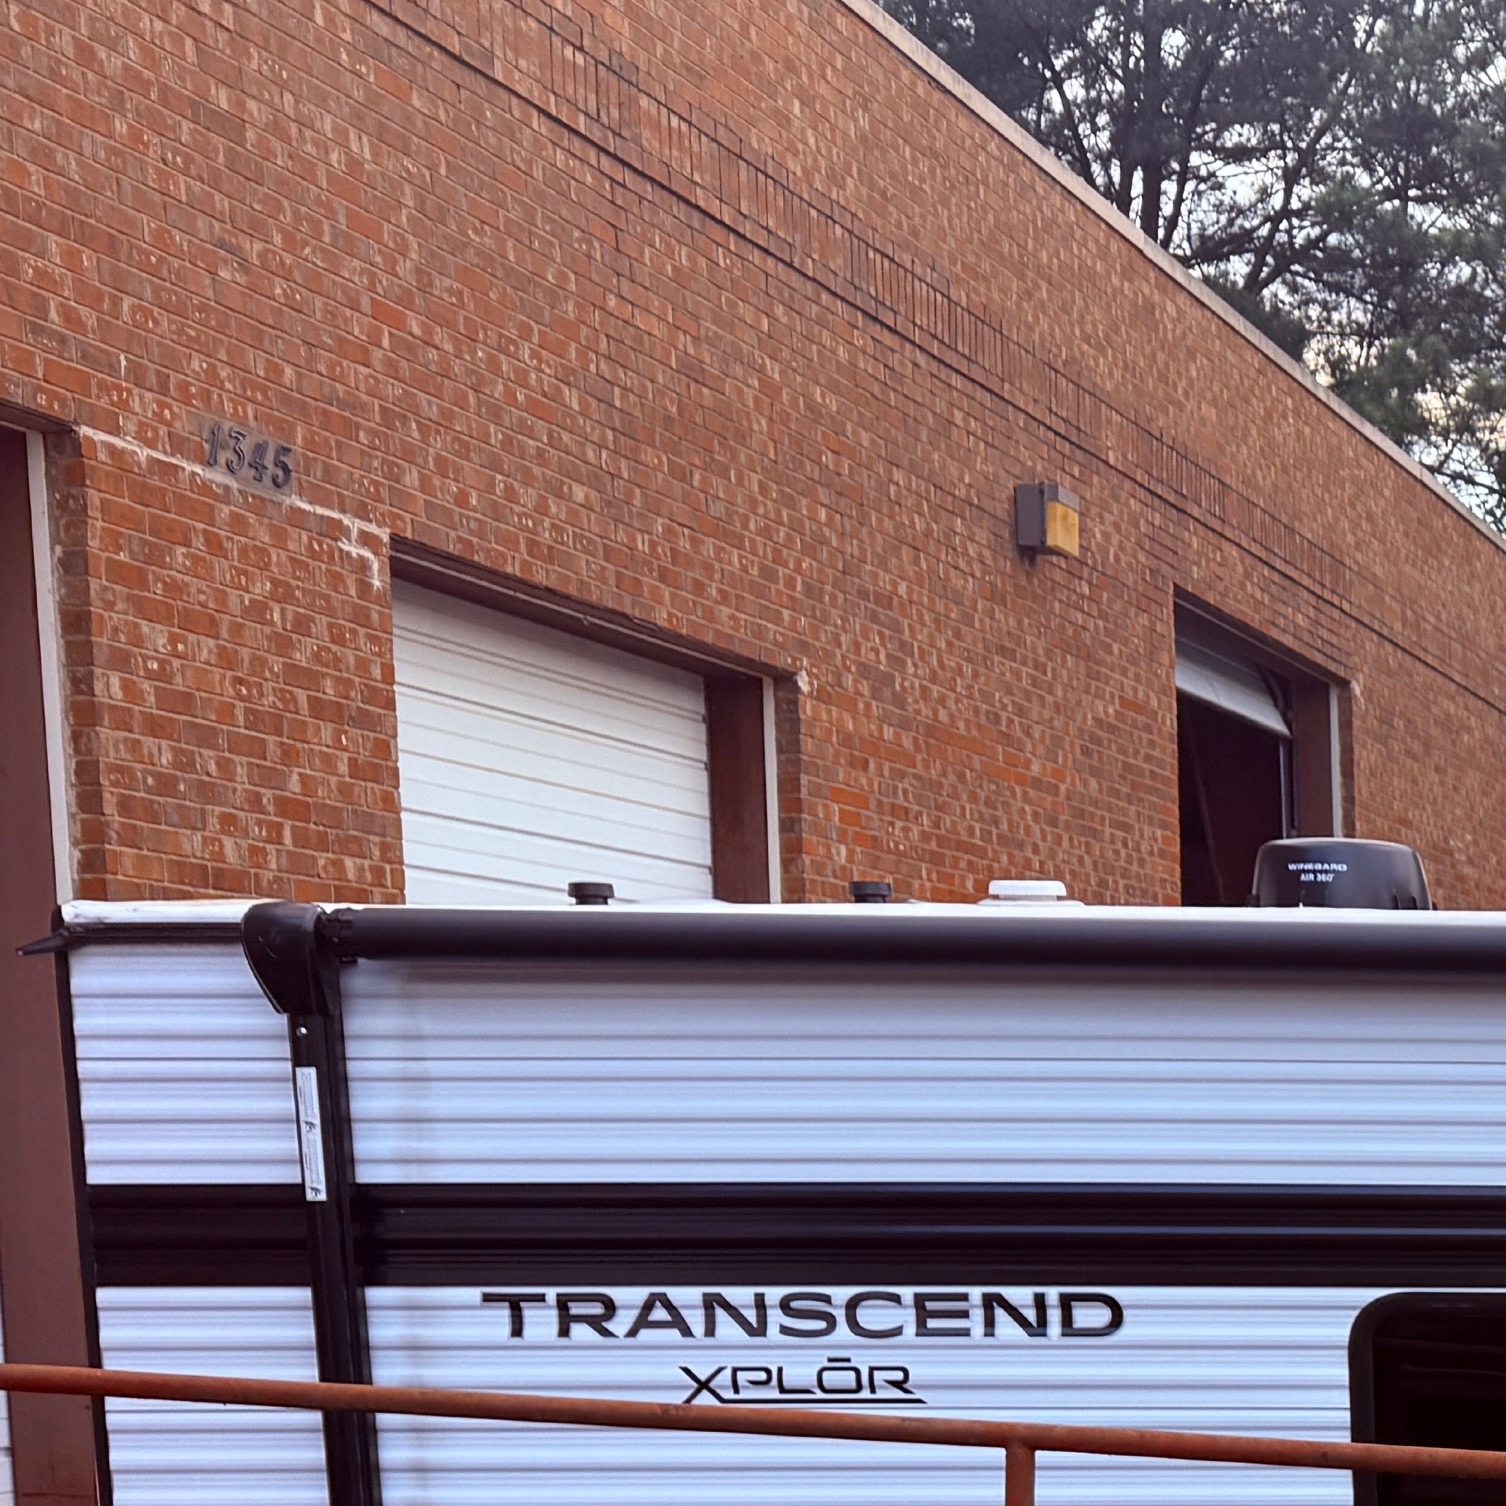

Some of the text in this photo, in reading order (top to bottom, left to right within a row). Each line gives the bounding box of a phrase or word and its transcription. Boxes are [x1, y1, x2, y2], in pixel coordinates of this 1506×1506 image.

[206, 424, 293, 489] 1345
[1301, 873, 1314, 881] AIR
[481, 1291, 1125, 1339] TRANSCEND
